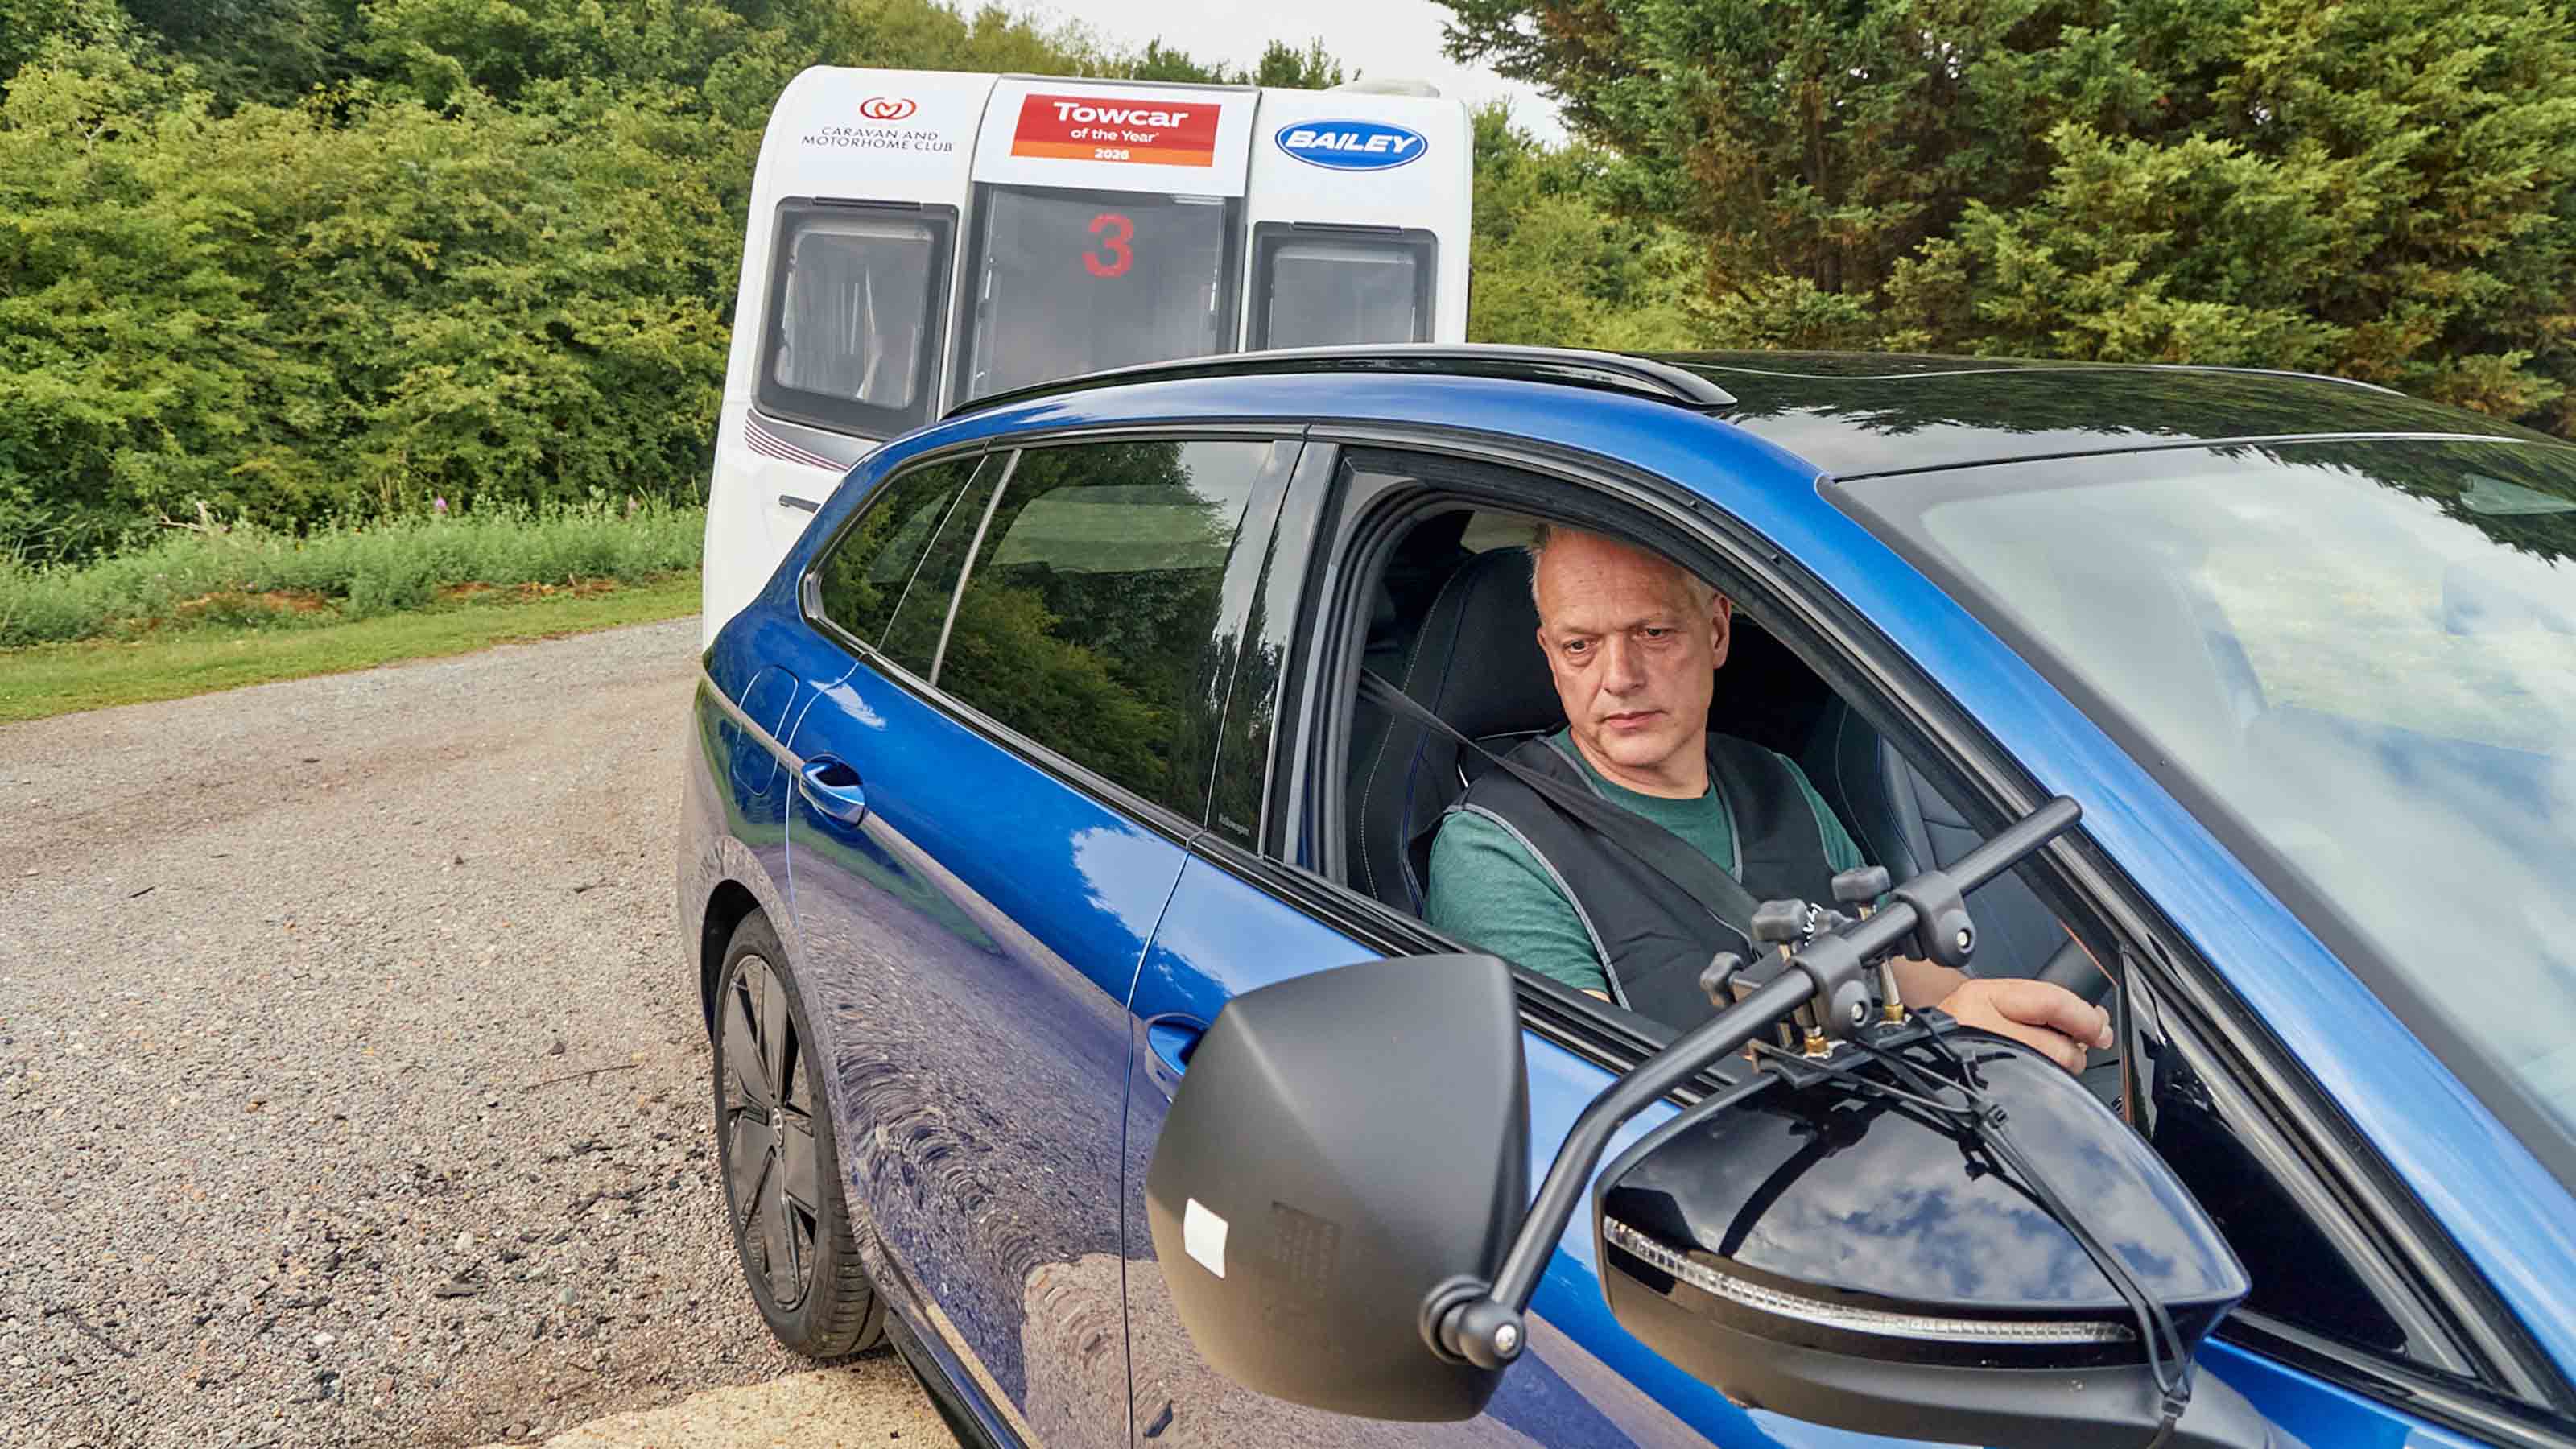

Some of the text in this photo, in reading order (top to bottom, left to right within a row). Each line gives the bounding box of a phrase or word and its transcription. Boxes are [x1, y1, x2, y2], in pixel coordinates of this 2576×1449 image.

[1053, 101, 1189, 127] Towcar
[821, 126, 938, 141] CARAVAN AND
[1071, 128, 1088, 138] of
[1092, 129, 1117, 141] the
[1285, 130, 1418, 154] BAILEY
[801, 135, 953, 152] MOTORHOME CLUB
[1094, 148, 1129, 160] 2026
[1082, 212, 1134, 279] 3
